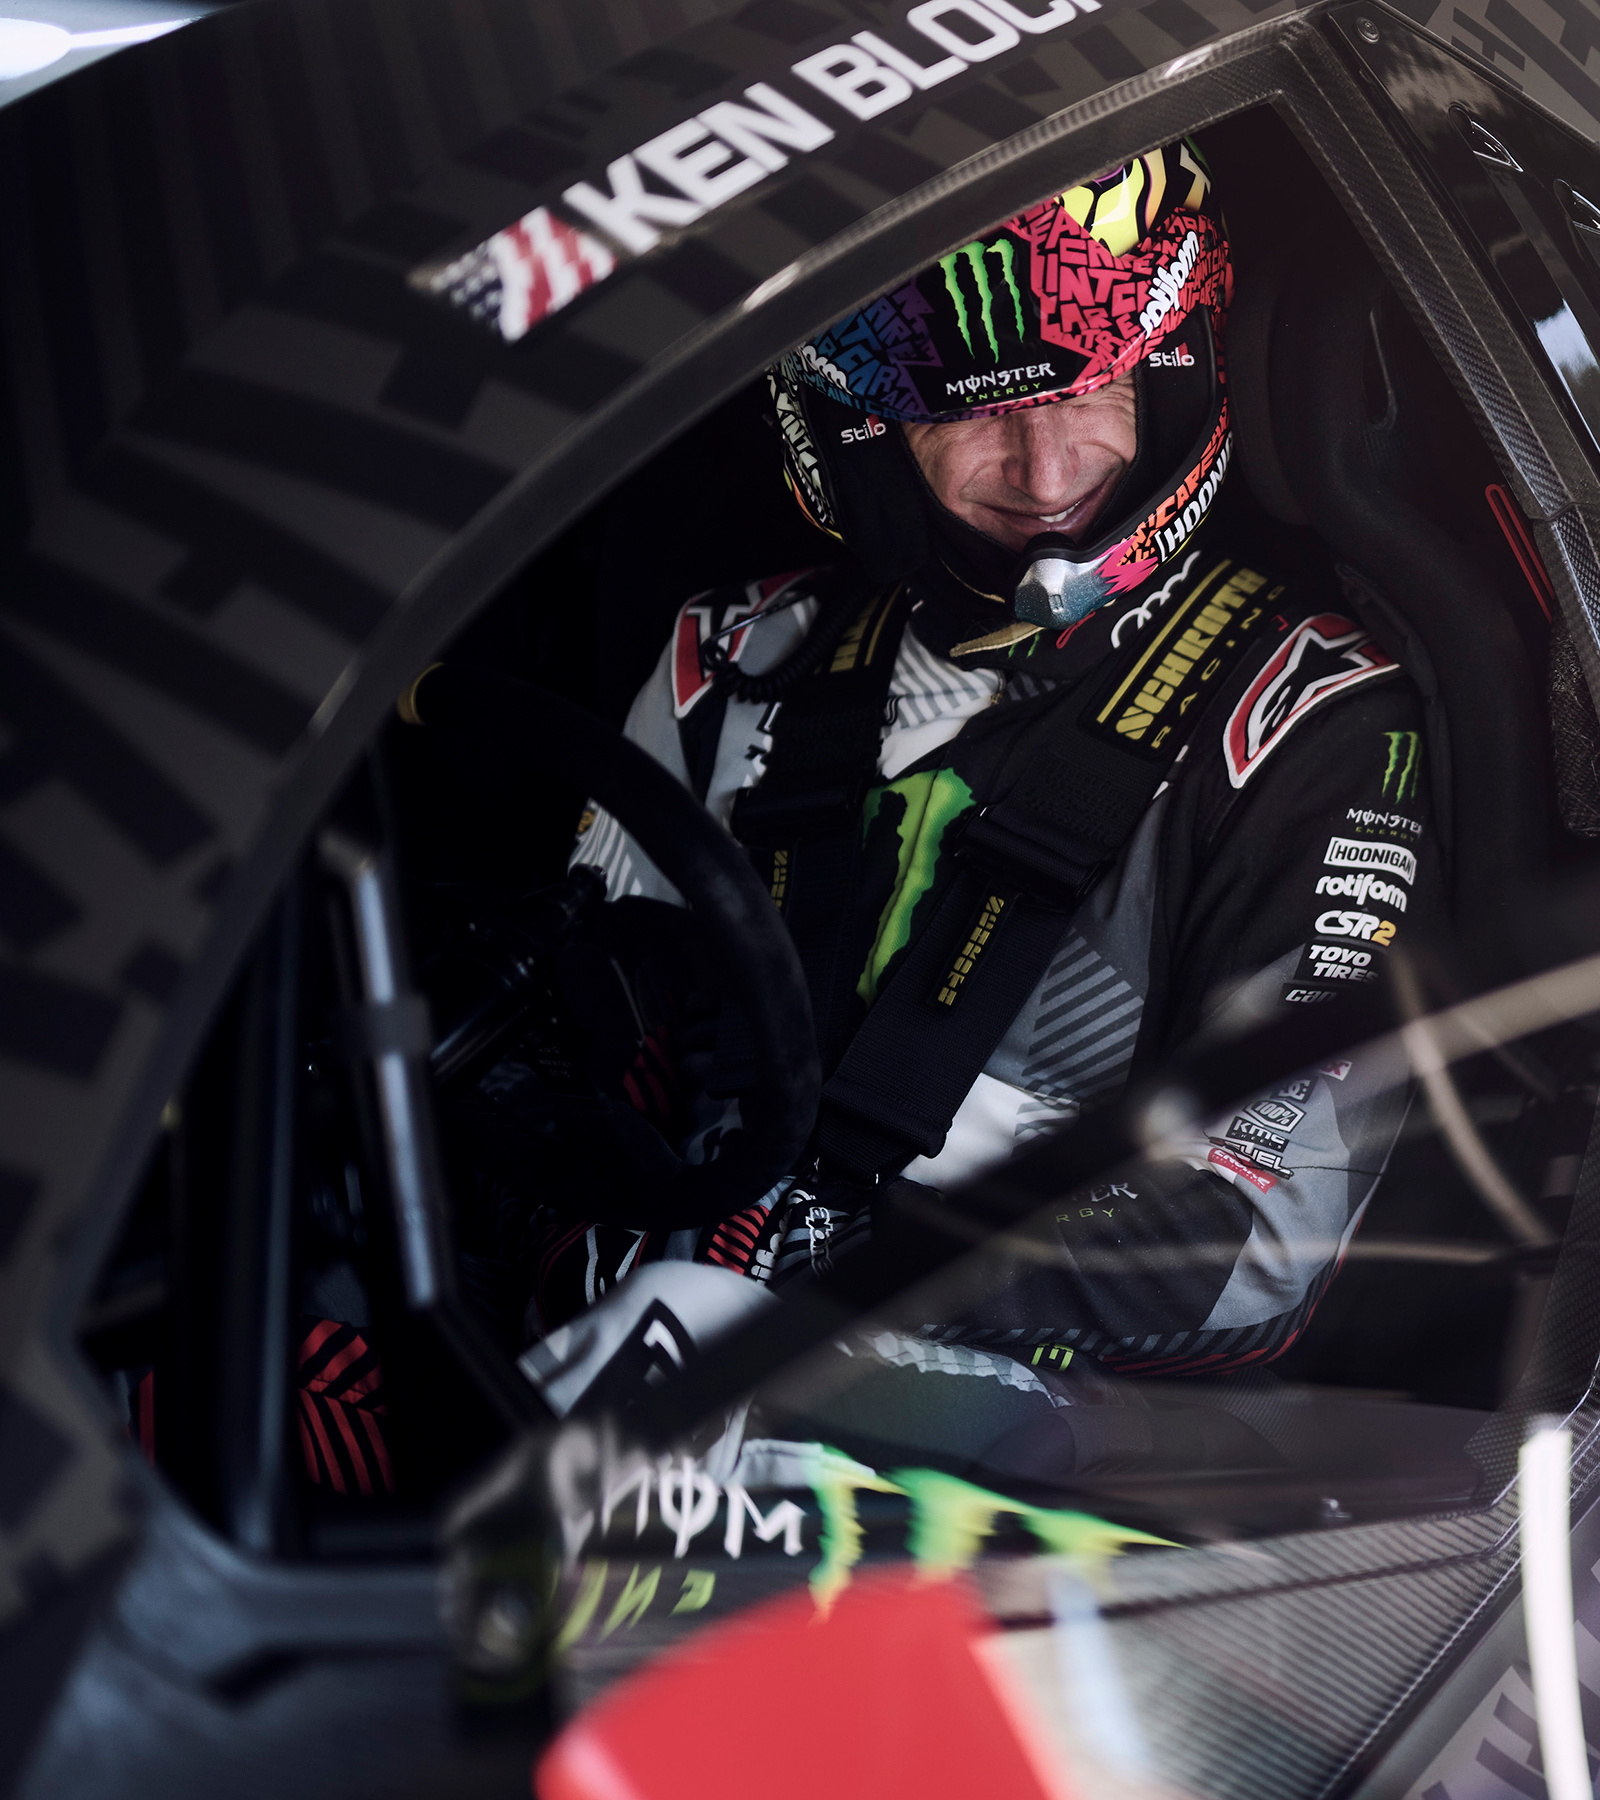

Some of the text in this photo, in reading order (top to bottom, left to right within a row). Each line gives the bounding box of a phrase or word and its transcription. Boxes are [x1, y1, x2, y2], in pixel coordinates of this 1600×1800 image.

[563, 0, 1103, 255] KEN BLOC
[1140, 230, 1201, 337] rotiform
[945, 361, 1056, 396] MONSTER
[965, 381, 1042, 403] ENERGY
[1115, 567, 1268, 740] SCHROTH
[1151, 585, 1285, 749] RACING
[1315, 872, 1407, 913] rotiform
[1314, 909, 1397, 947] CSR2
[937, 894, 1005, 1006] SCHROTH
[1308, 944, 1372, 966] TOYO
[1312, 961, 1380, 983] TIRES
[1254, 1101, 1298, 1125] 100%
